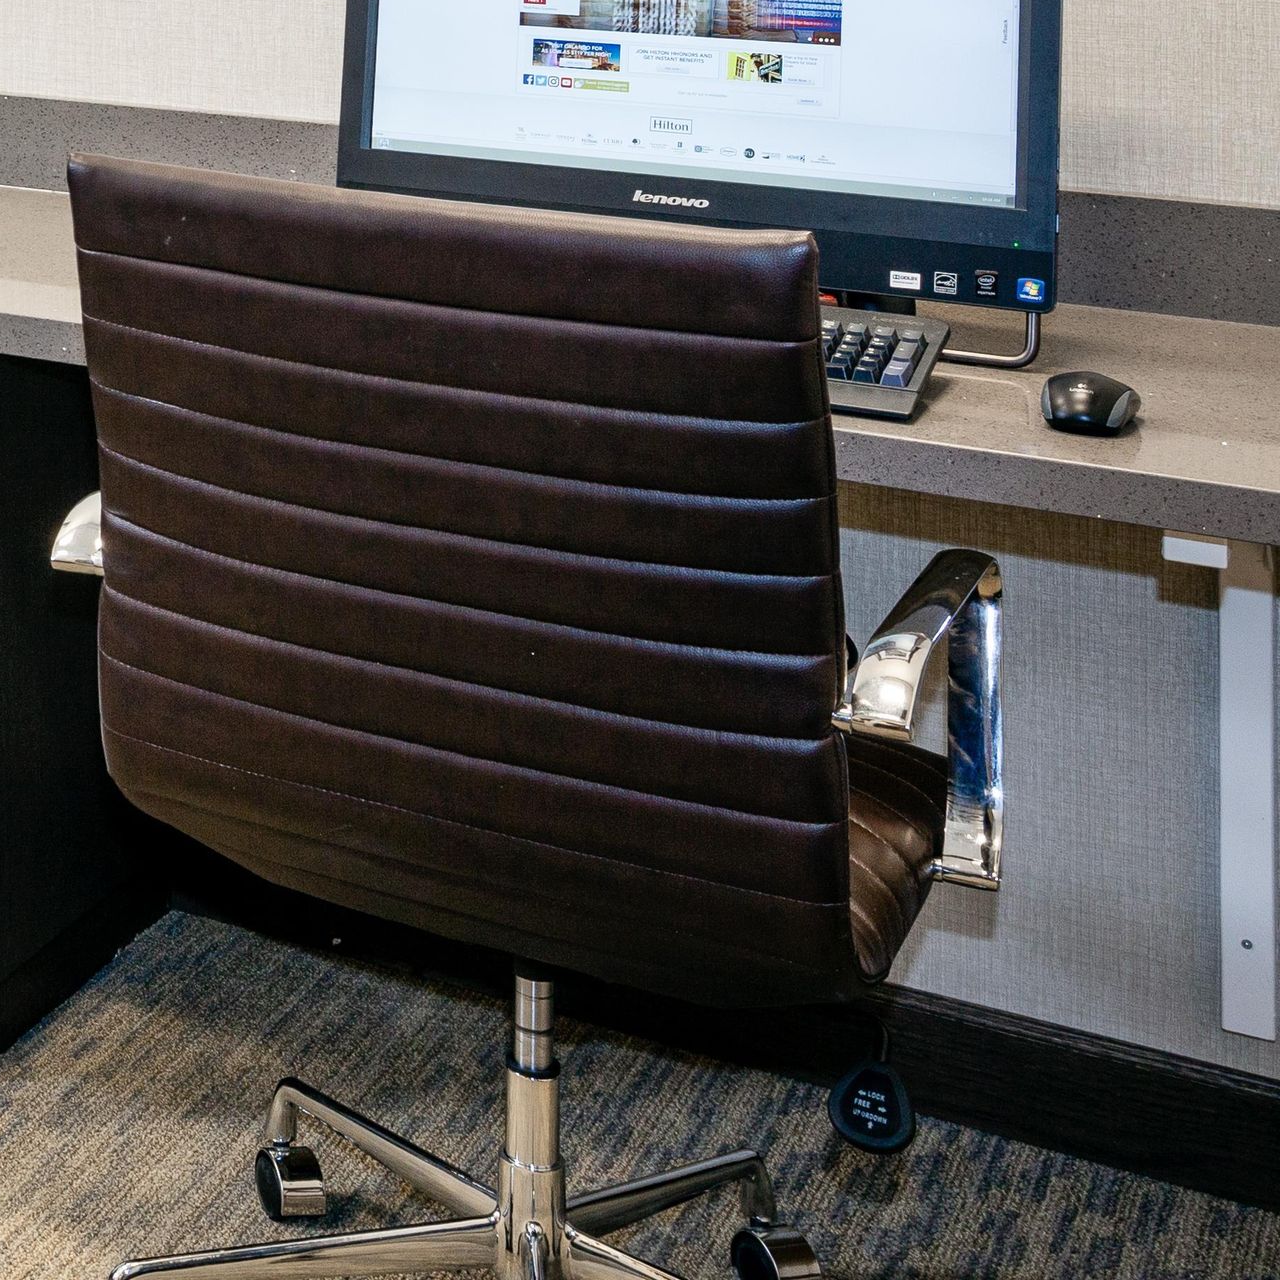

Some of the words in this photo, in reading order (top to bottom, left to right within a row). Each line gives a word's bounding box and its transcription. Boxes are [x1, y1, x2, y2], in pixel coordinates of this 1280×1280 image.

[653, 120, 689, 131] Hilton
[633, 190, 710, 208] lenovo
[867, 1091, 885, 1101] LOCK
[854, 1098, 871, 1108] FREE
